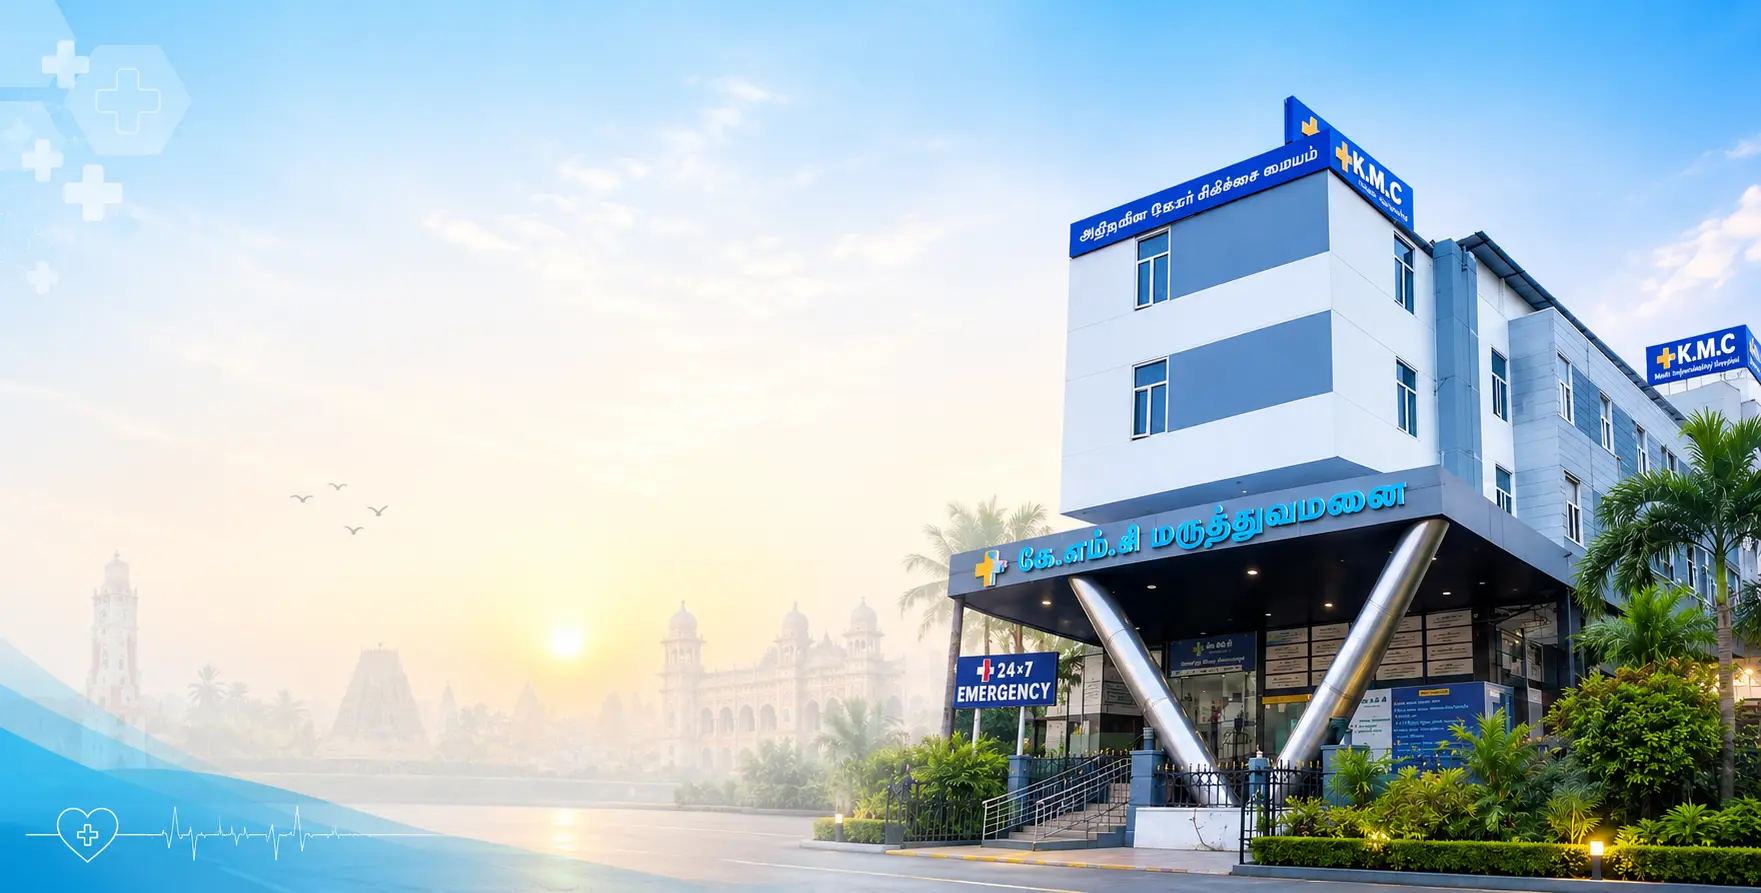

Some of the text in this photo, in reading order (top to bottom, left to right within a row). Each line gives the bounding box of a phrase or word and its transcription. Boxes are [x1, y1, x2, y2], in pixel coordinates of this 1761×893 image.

[1352, 150, 1403, 205] K.M.C
[1677, 333, 1736, 364] K.M.C
[1150, 481, 1408, 550] மருத்துவமனை
[957, 682, 1051, 703] EMERGENCY
